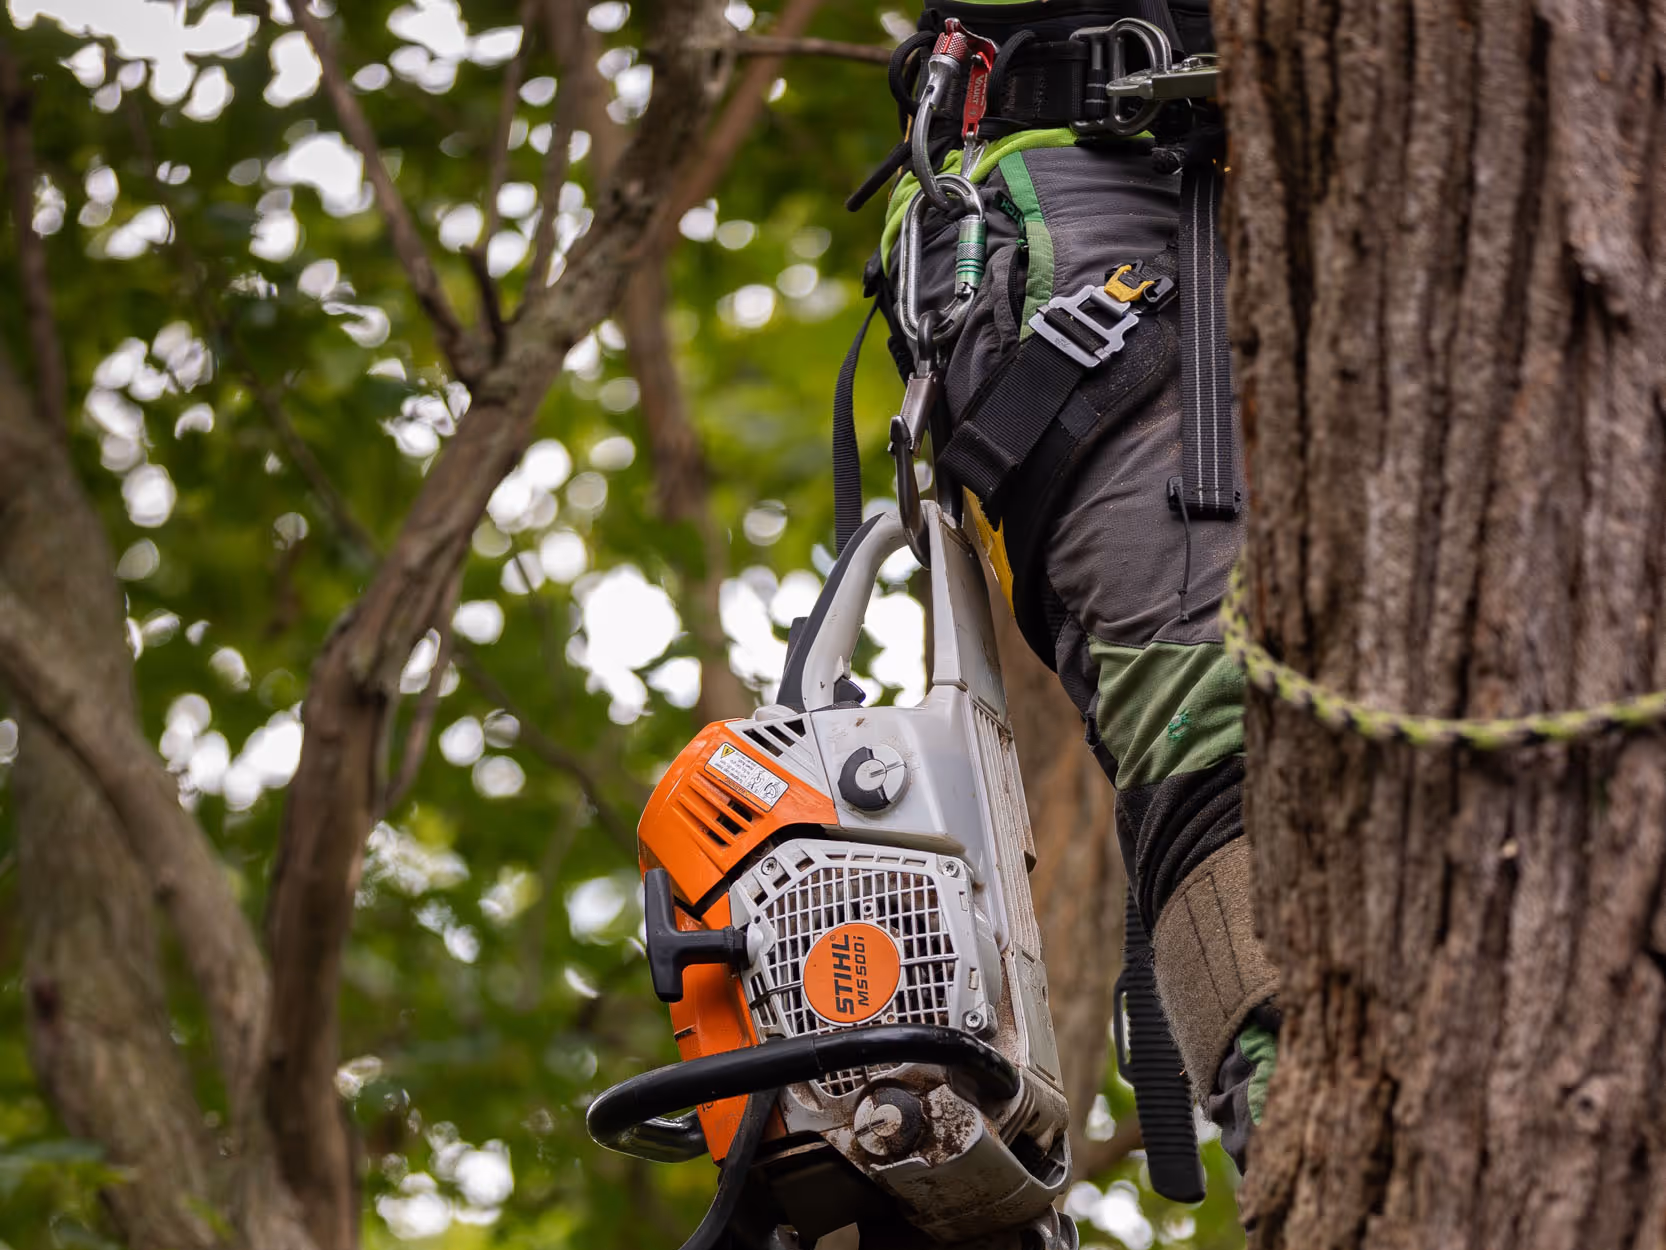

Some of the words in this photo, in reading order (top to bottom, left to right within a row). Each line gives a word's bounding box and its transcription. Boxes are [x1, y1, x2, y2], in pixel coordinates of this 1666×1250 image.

[973, 74, 985, 105] VAULT
[831, 934, 855, 1015] STIHL
[856, 979, 869, 1007] MS
